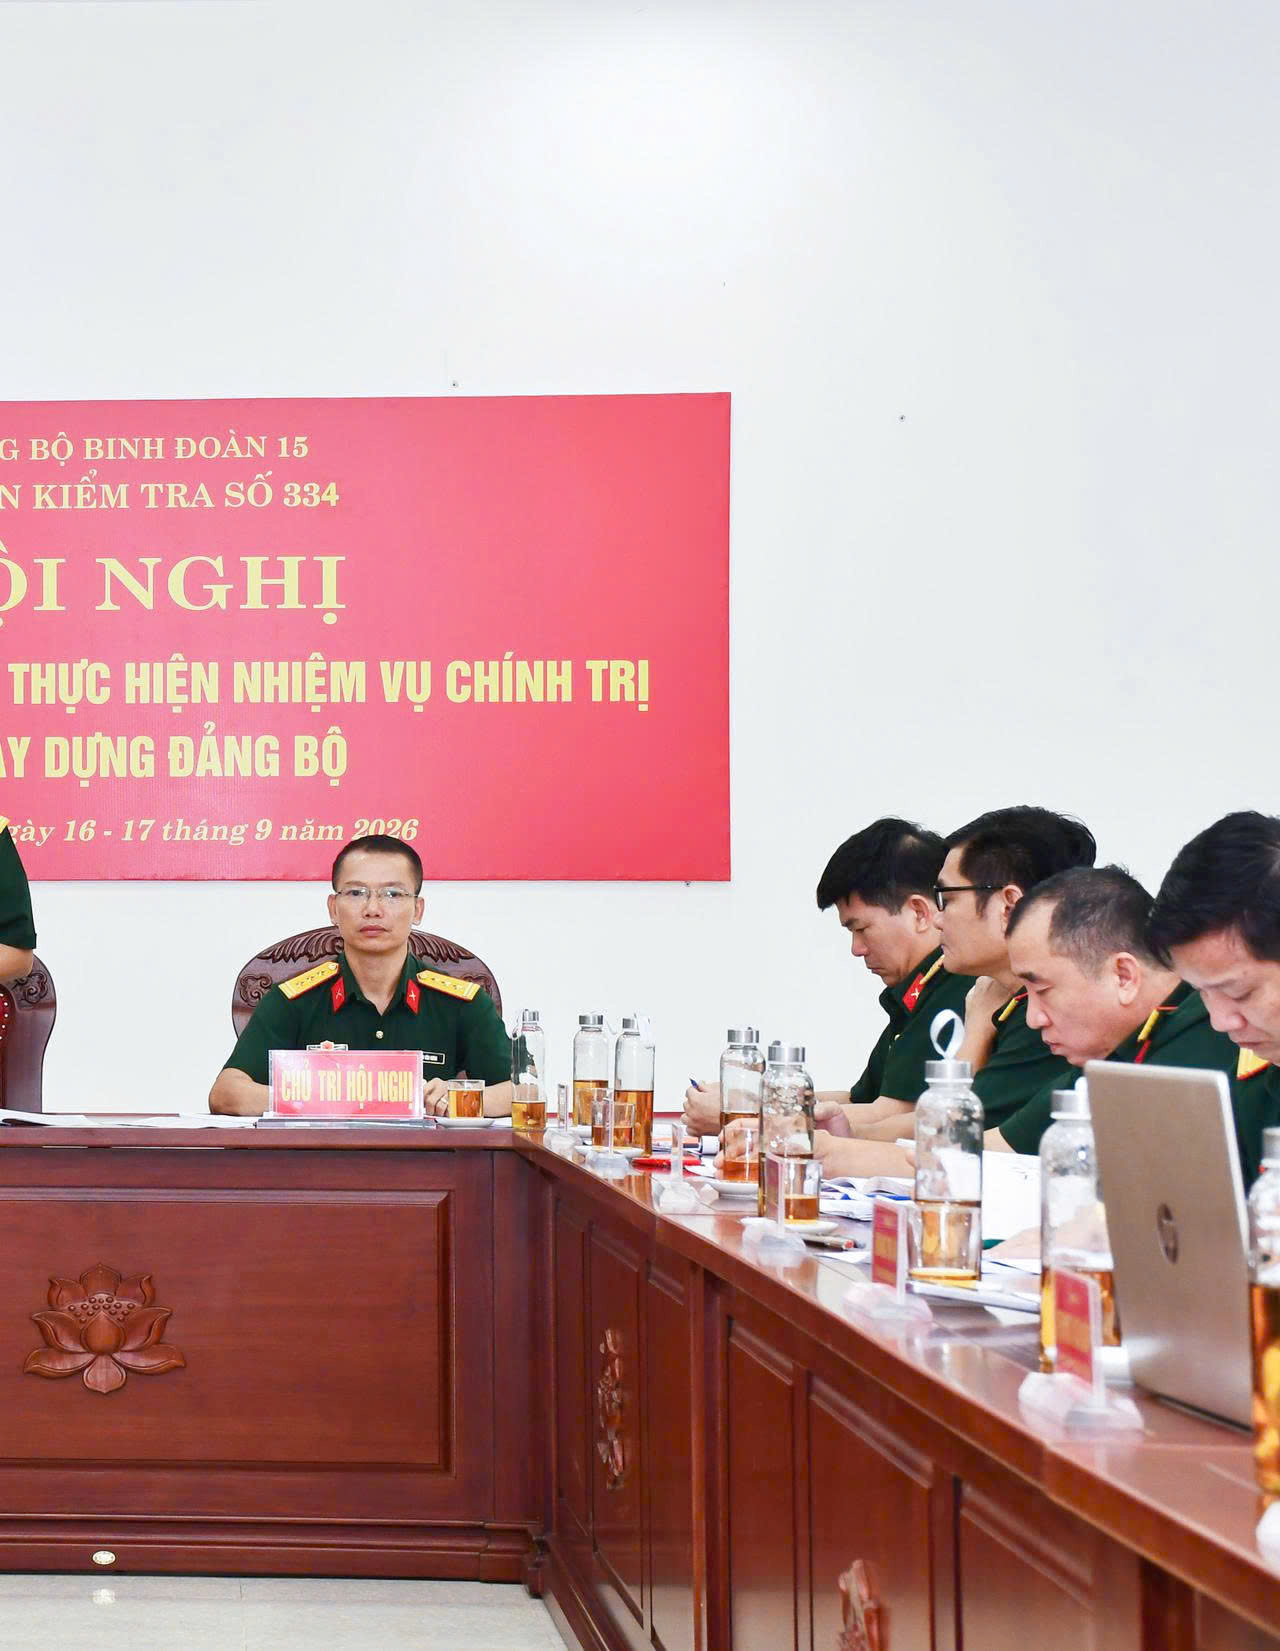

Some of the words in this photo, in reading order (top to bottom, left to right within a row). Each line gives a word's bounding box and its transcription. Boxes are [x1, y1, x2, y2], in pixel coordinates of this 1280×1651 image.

[29, 432, 74, 467] BỘ
[84, 437, 164, 460] BINH
[175, 429, 267, 459] ĐOÀN
[278, 436, 309, 458] 15
[32, 469, 129, 510] KIỂM
[140, 483, 215, 509] TRA
[224, 471, 273, 508] SỐ
[283, 482, 340, 507] 334
[96, 555, 347, 625] NGHỊ
[8, 658, 111, 714] THỰC
[125, 653, 219, 714] HIỆN
[234, 652, 367, 713] NHIỆM
[380, 661, 432, 713] VỤ
[446, 651, 573, 703] CHÍNH
[586, 659, 650, 712] TRỊ
[44, 732, 155, 788] DỰNG
[167, 721, 280, 778] ĐẢNG
[294, 726, 348, 787] BỘ
[8, 818, 56, 847] gày
[63, 819, 97, 842] 16
[121, 819, 157, 842] 17
[162, 818, 249, 846] tháng
[254, 818, 273, 841] 9
[279, 818, 344, 841] năm
[351, 818, 419, 841] 2026
[281, 1058, 312, 1102] CHỦ
[318, 1063, 342, 1102] TRÌ
[346, 1066, 373, 1110] HỘI
[377, 1071, 414, 1110] NGHỊ
